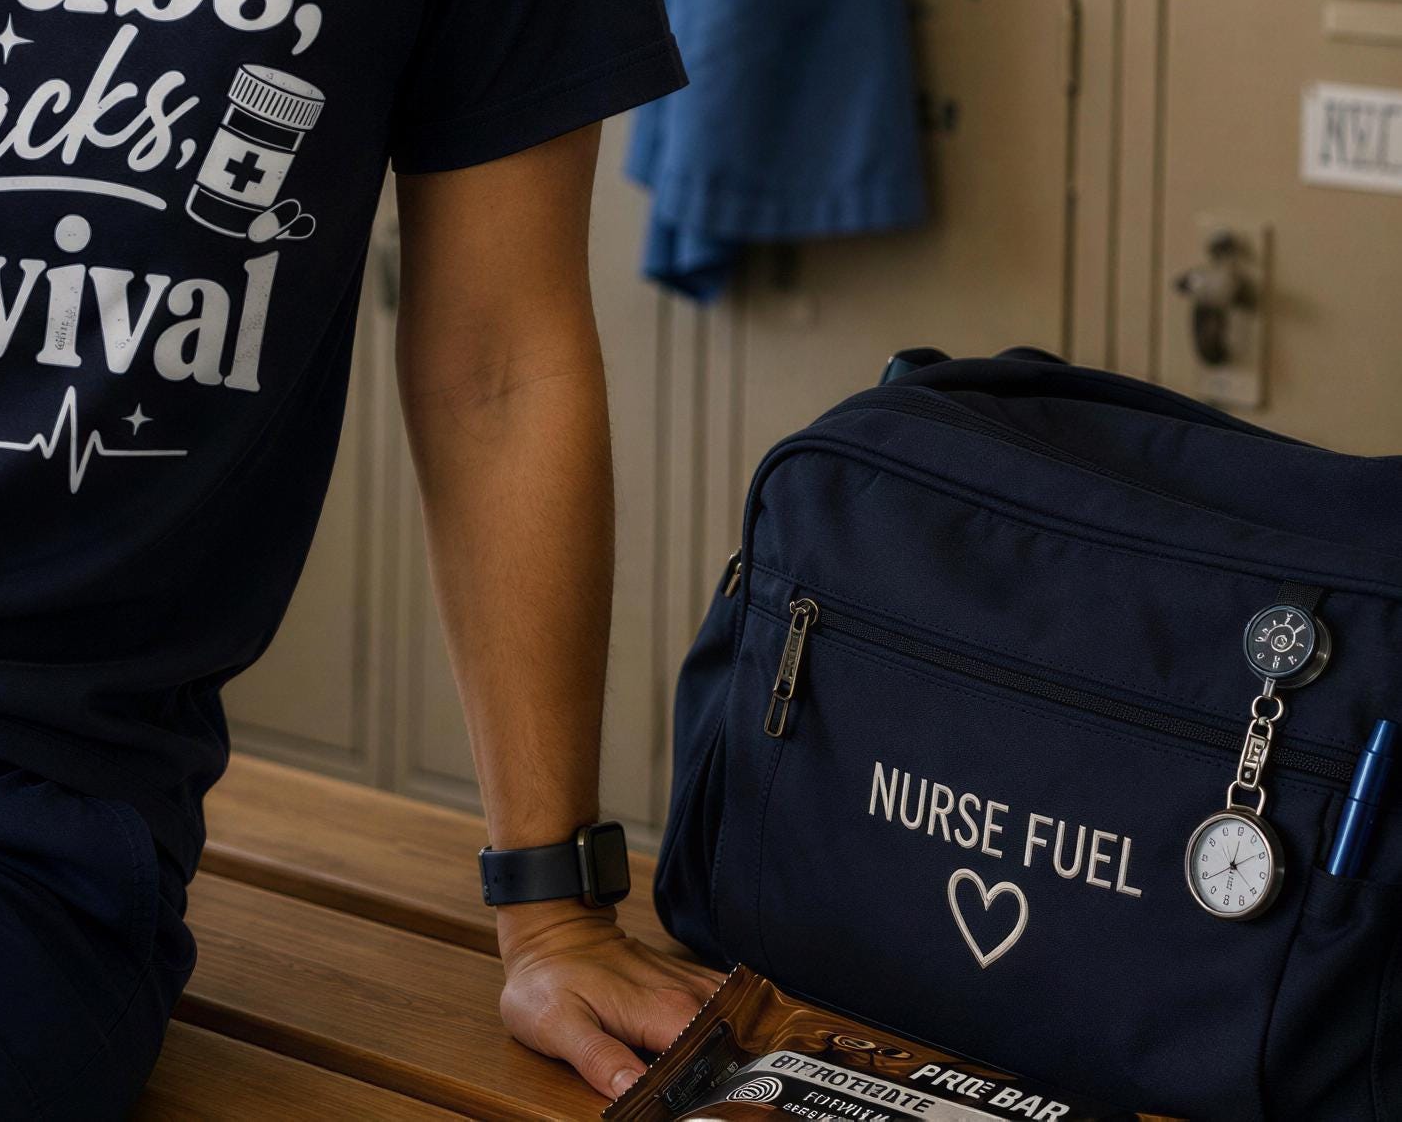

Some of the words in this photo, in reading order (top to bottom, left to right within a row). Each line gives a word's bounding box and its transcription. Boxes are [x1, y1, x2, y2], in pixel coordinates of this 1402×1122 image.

[868, 761, 1010, 858] NURSE
[1023, 812, 1143, 900] FUEL
[988, 1087, 1071, 1122] BAR
